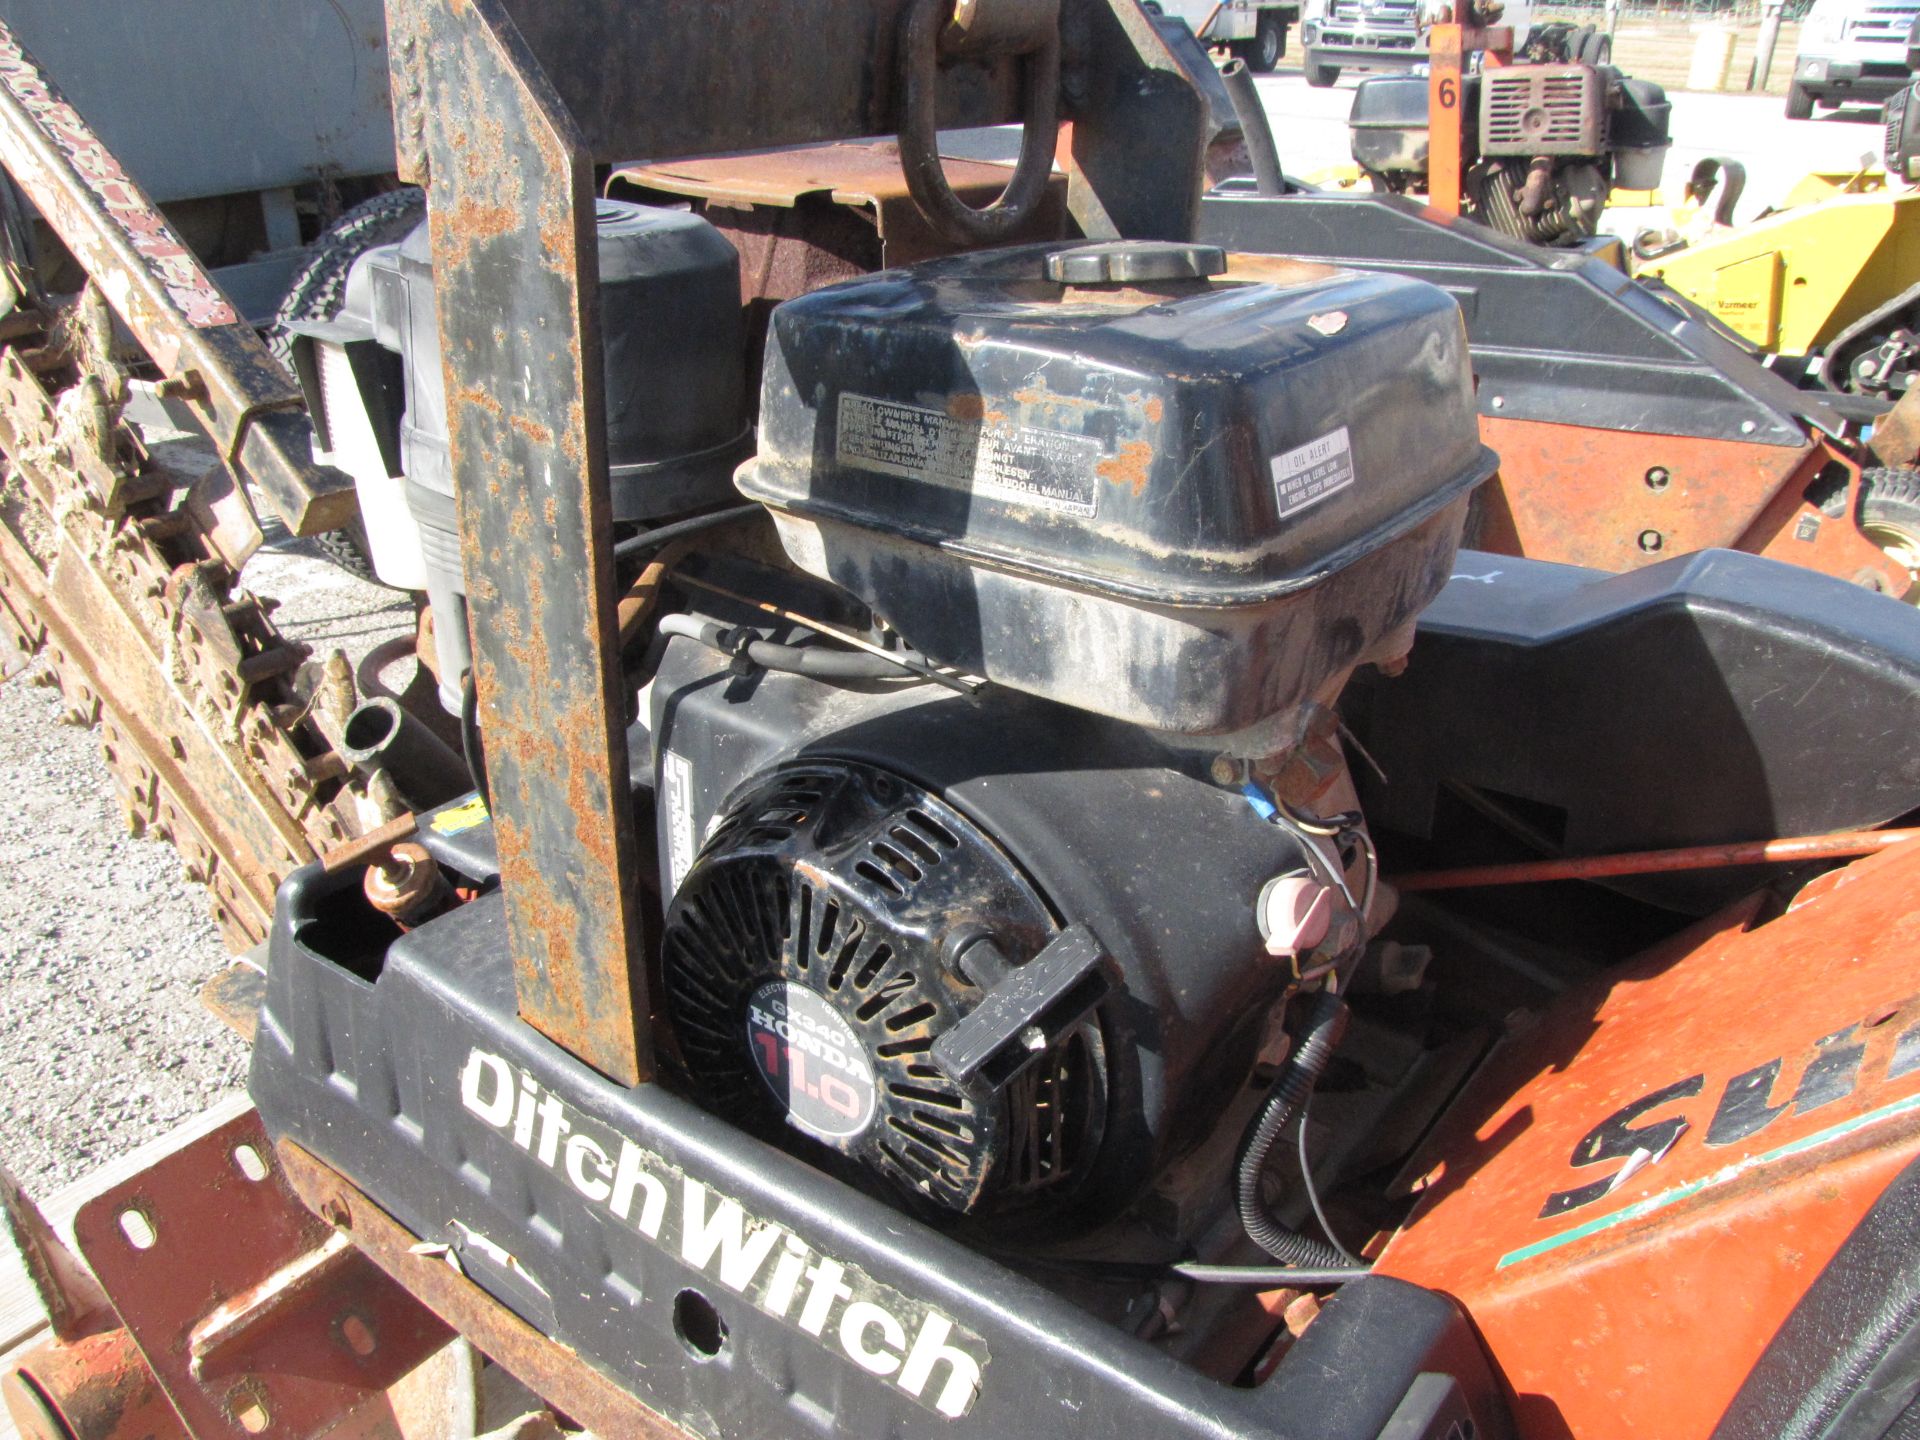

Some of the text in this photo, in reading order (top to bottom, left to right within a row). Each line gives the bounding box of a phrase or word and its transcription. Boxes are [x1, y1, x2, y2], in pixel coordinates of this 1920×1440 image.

[1439, 78, 1456, 108] 6
[877, 406, 920, 421] OWNER'S
[1003, 441, 1037, 457] AVANT
[1293, 441, 1330, 468] OIL ALERT
[1041, 484, 1086, 503] MANUAL
[758, 983, 809, 999] ELECTRONIC
[771, 999, 846, 1048] GX340
[821, 1001, 860, 1049] IGNITION
[750, 1005, 875, 1086] HONDA
[754, 1032, 860, 1119] 11.0
